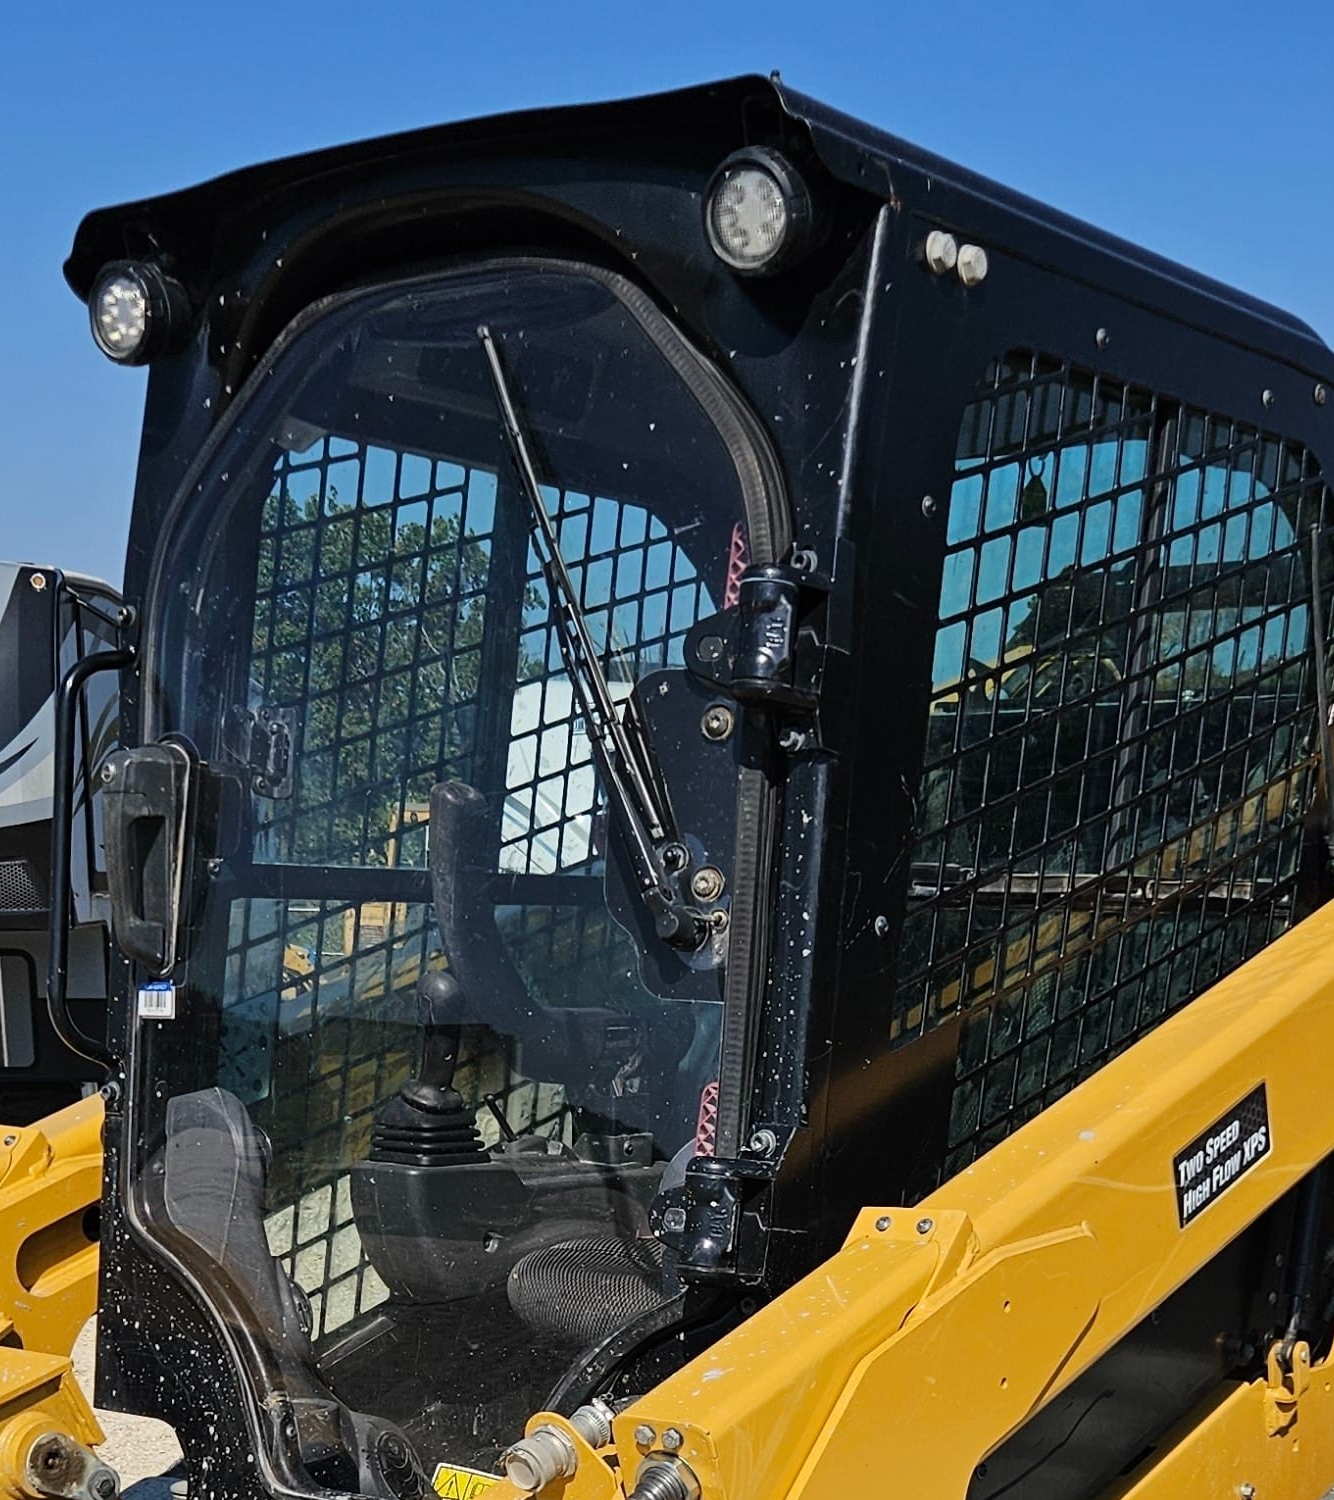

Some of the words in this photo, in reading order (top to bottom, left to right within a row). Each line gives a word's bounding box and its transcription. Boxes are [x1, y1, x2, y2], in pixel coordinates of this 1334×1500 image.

[1178, 1150, 1204, 1188] TWO
[1205, 1120, 1240, 1165] SPEED
[1183, 1180, 1211, 1218] HIGH
[1212, 1150, 1242, 1192] FLOW
[1243, 1126, 1267, 1165] XPS
